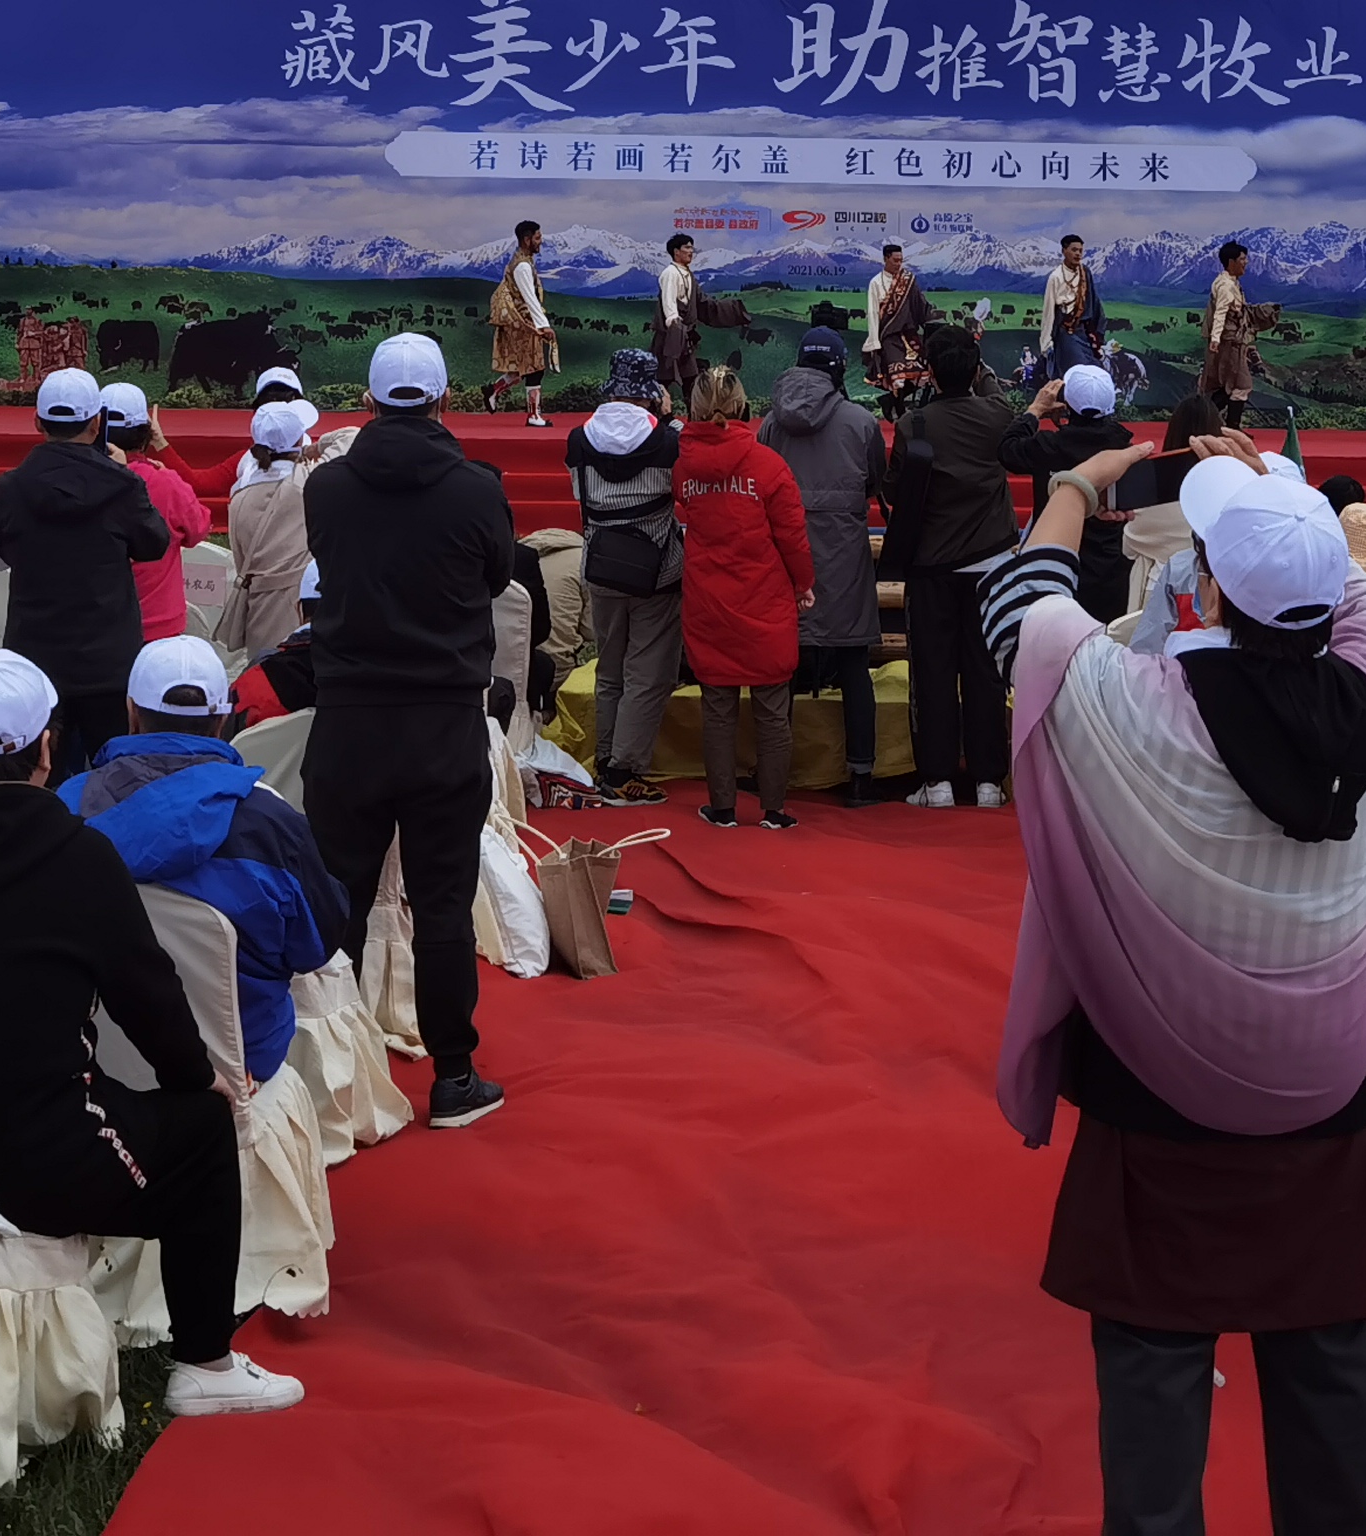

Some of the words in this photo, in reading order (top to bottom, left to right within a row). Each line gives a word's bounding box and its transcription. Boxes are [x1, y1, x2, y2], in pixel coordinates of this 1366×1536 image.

[469, 140, 790, 176] 若诗若画若尔盖
[845, 147, 1171, 183] 红色初心向未来
[834, 211, 887, 224] 四川卫视
[788, 265, 846, 277] 2021.06.19
